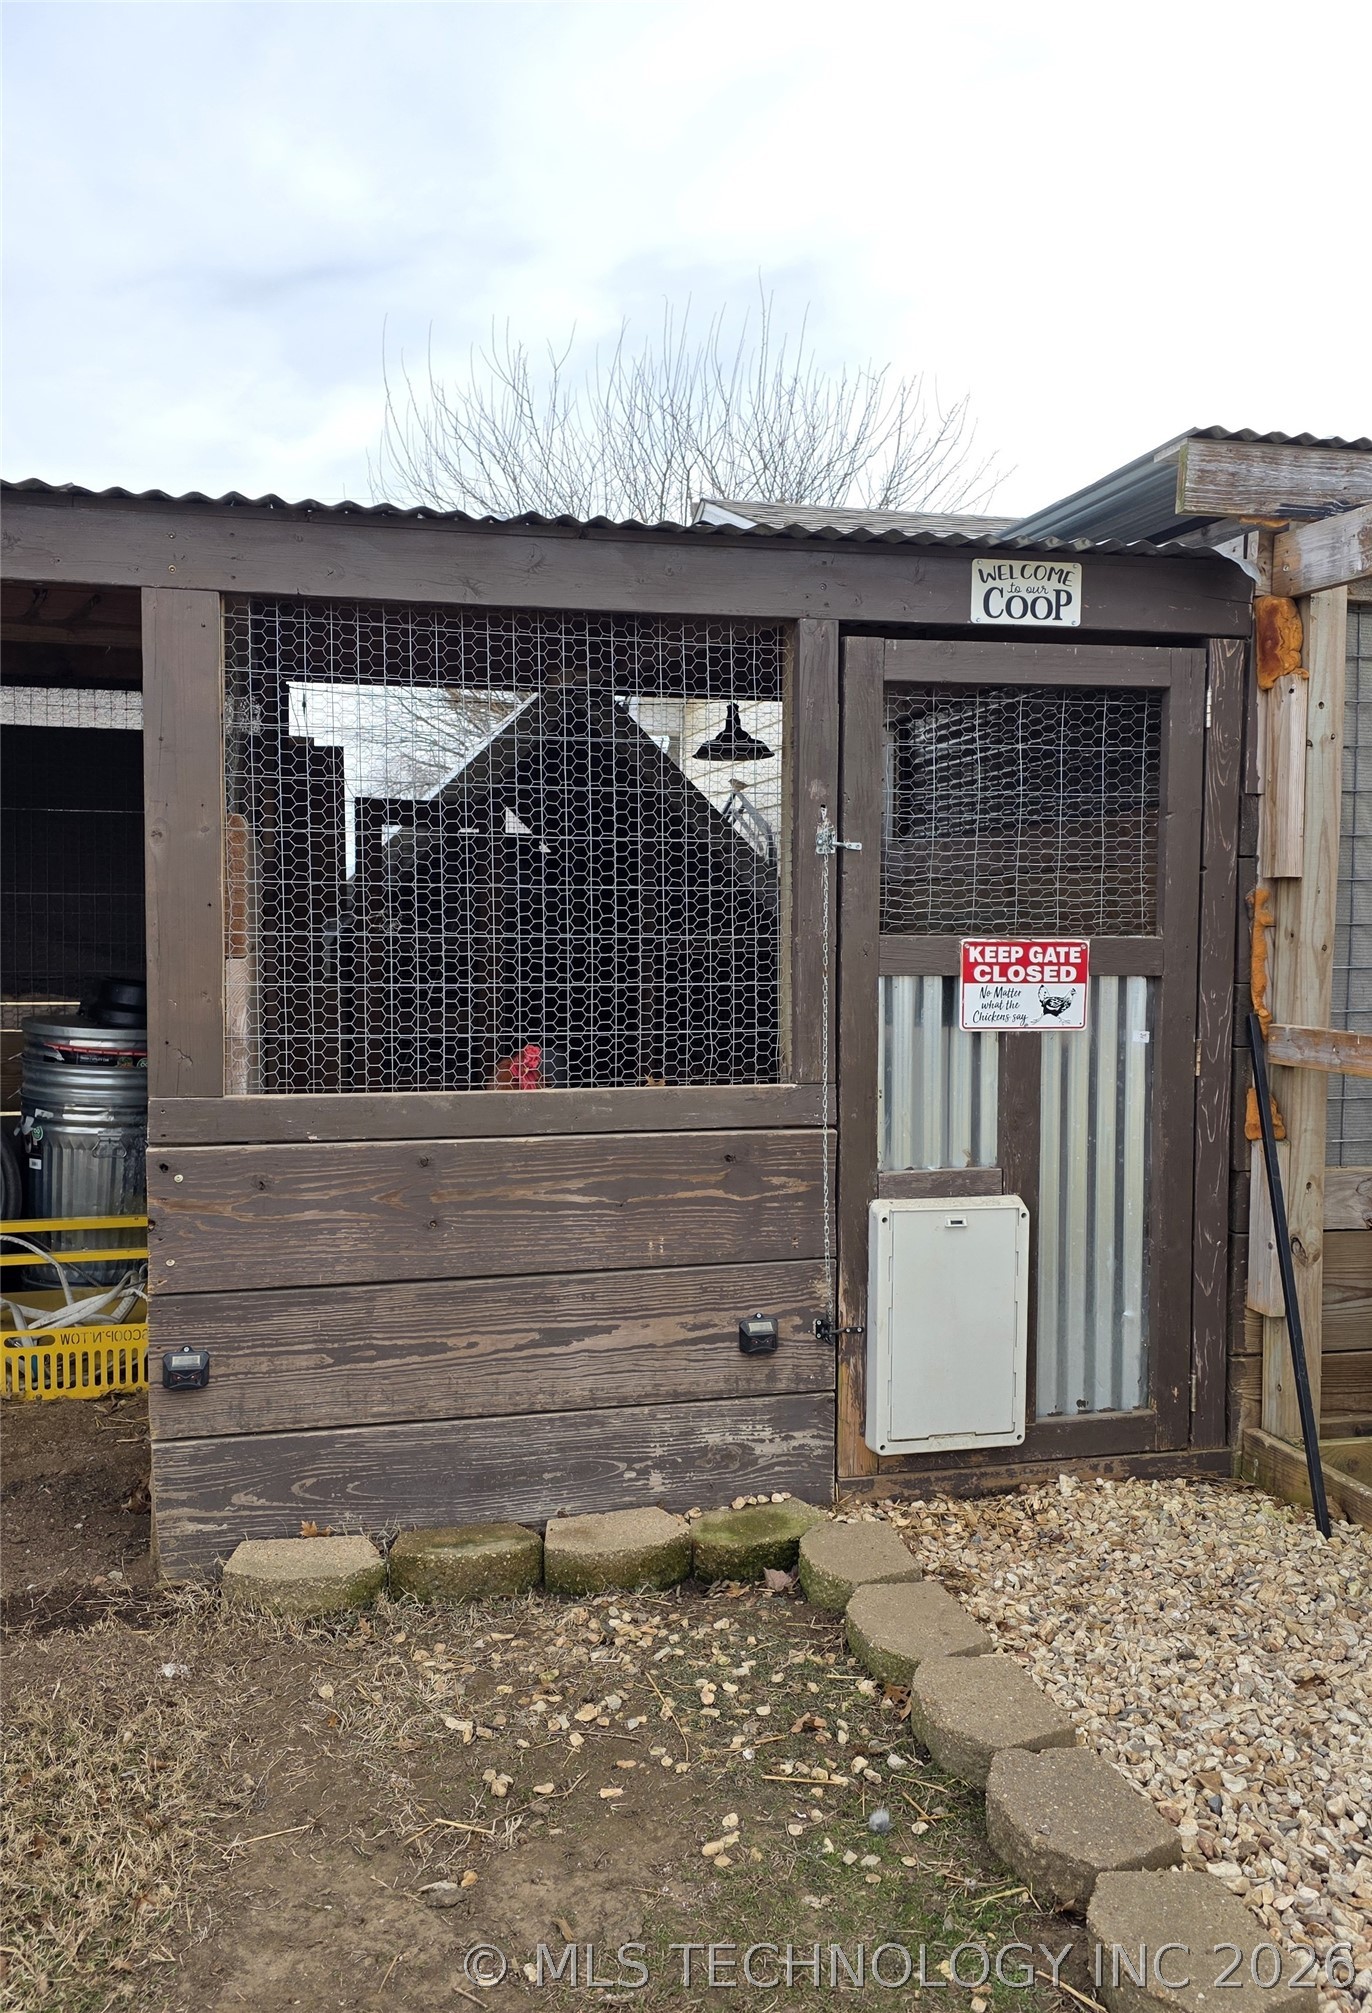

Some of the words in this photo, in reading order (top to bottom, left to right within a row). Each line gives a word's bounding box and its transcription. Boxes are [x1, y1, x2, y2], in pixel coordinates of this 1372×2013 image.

[977, 563, 1076, 588] WELCOME
[1007, 582, 1022, 594] to
[1025, 584, 1049, 595] our
[983, 586, 1073, 621] COOP
[969, 946, 1024, 963] KEEP
[1028, 946, 1081, 963] GATE
[973, 965, 1077, 983] CLOSED
[979, 986, 992, 999] No
[993, 986, 1022, 999] Matter
[981, 1000, 1004, 1010] what
[1005, 999, 1020, 1009] the
[972, 1010, 1011, 1024] Chickens
